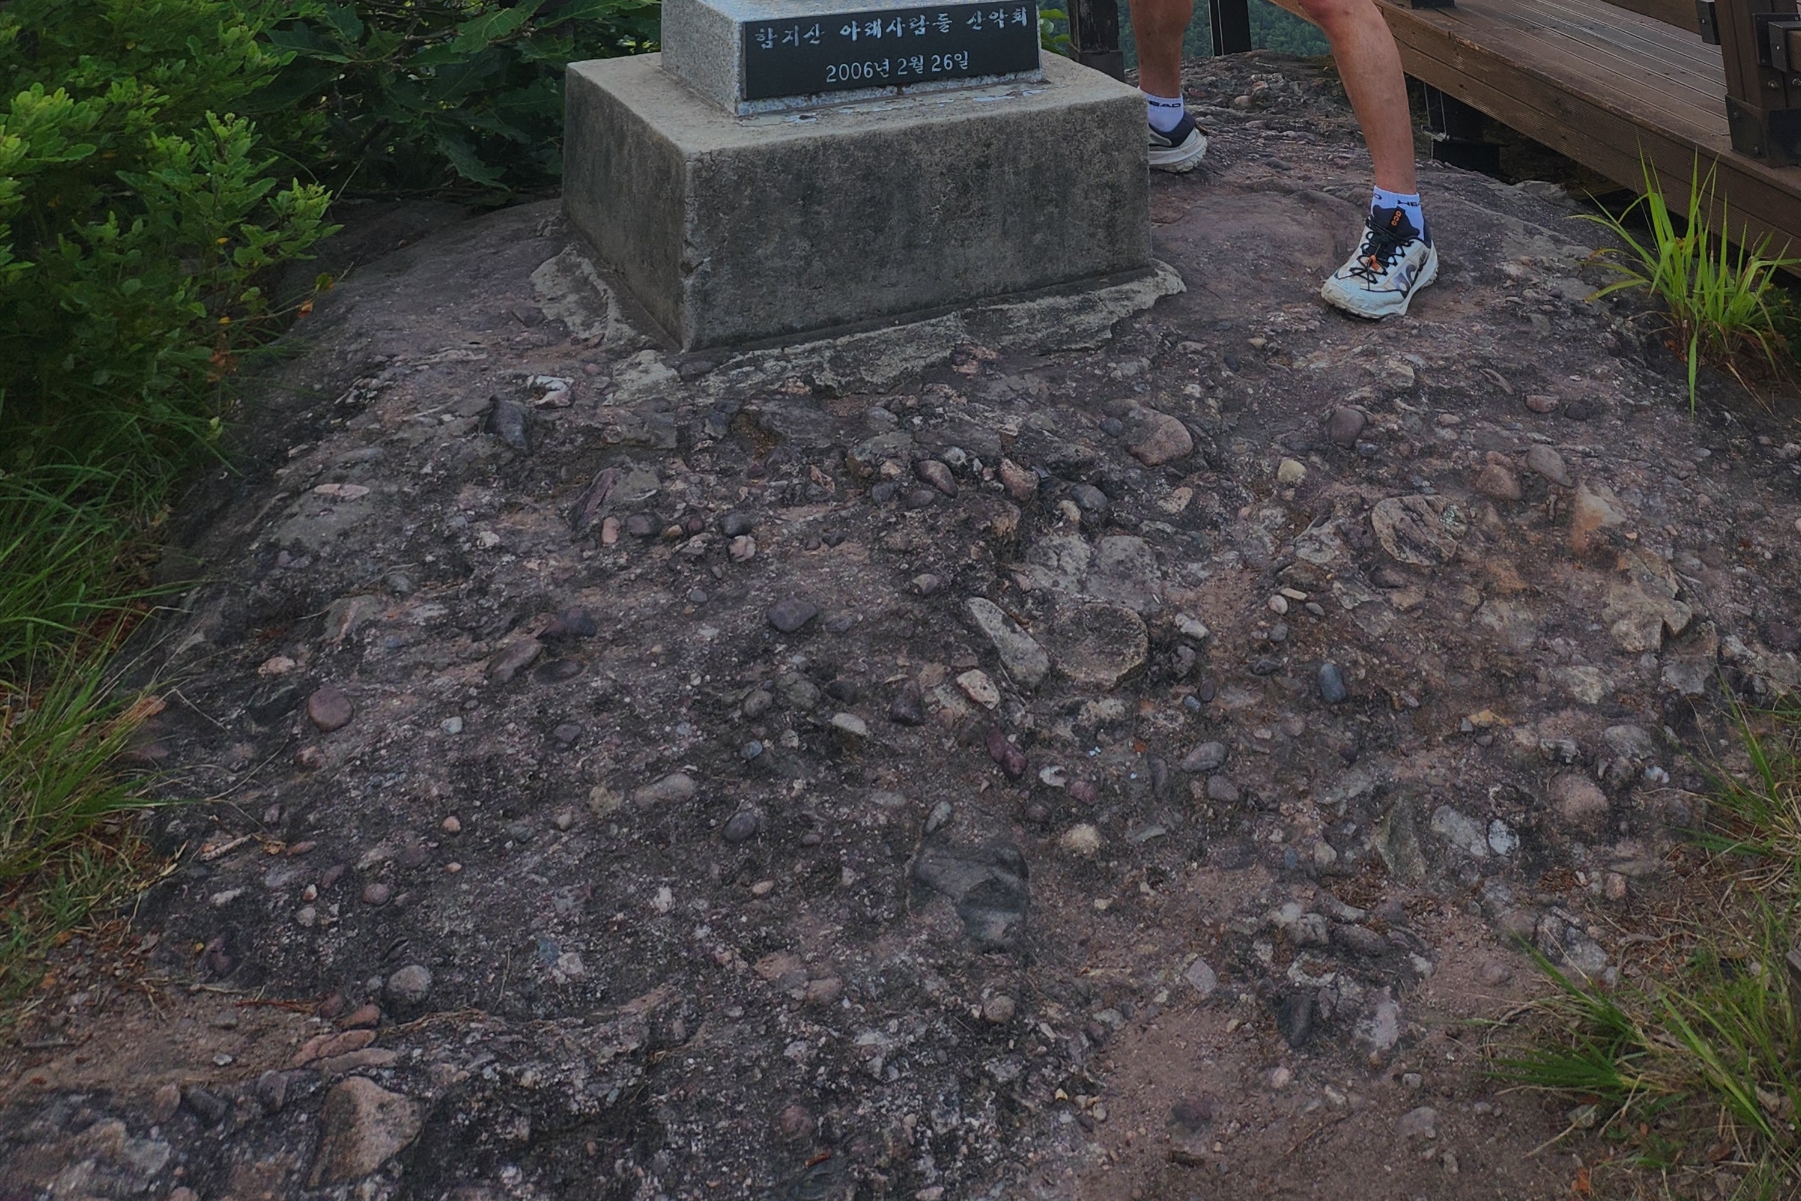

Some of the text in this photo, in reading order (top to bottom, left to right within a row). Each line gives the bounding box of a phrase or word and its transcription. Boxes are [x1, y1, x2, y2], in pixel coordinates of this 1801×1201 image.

[755, 6, 1028, 50] 함지산 아래사람들 산악회
[825, 50, 969, 83] 2006년 2월 26일
